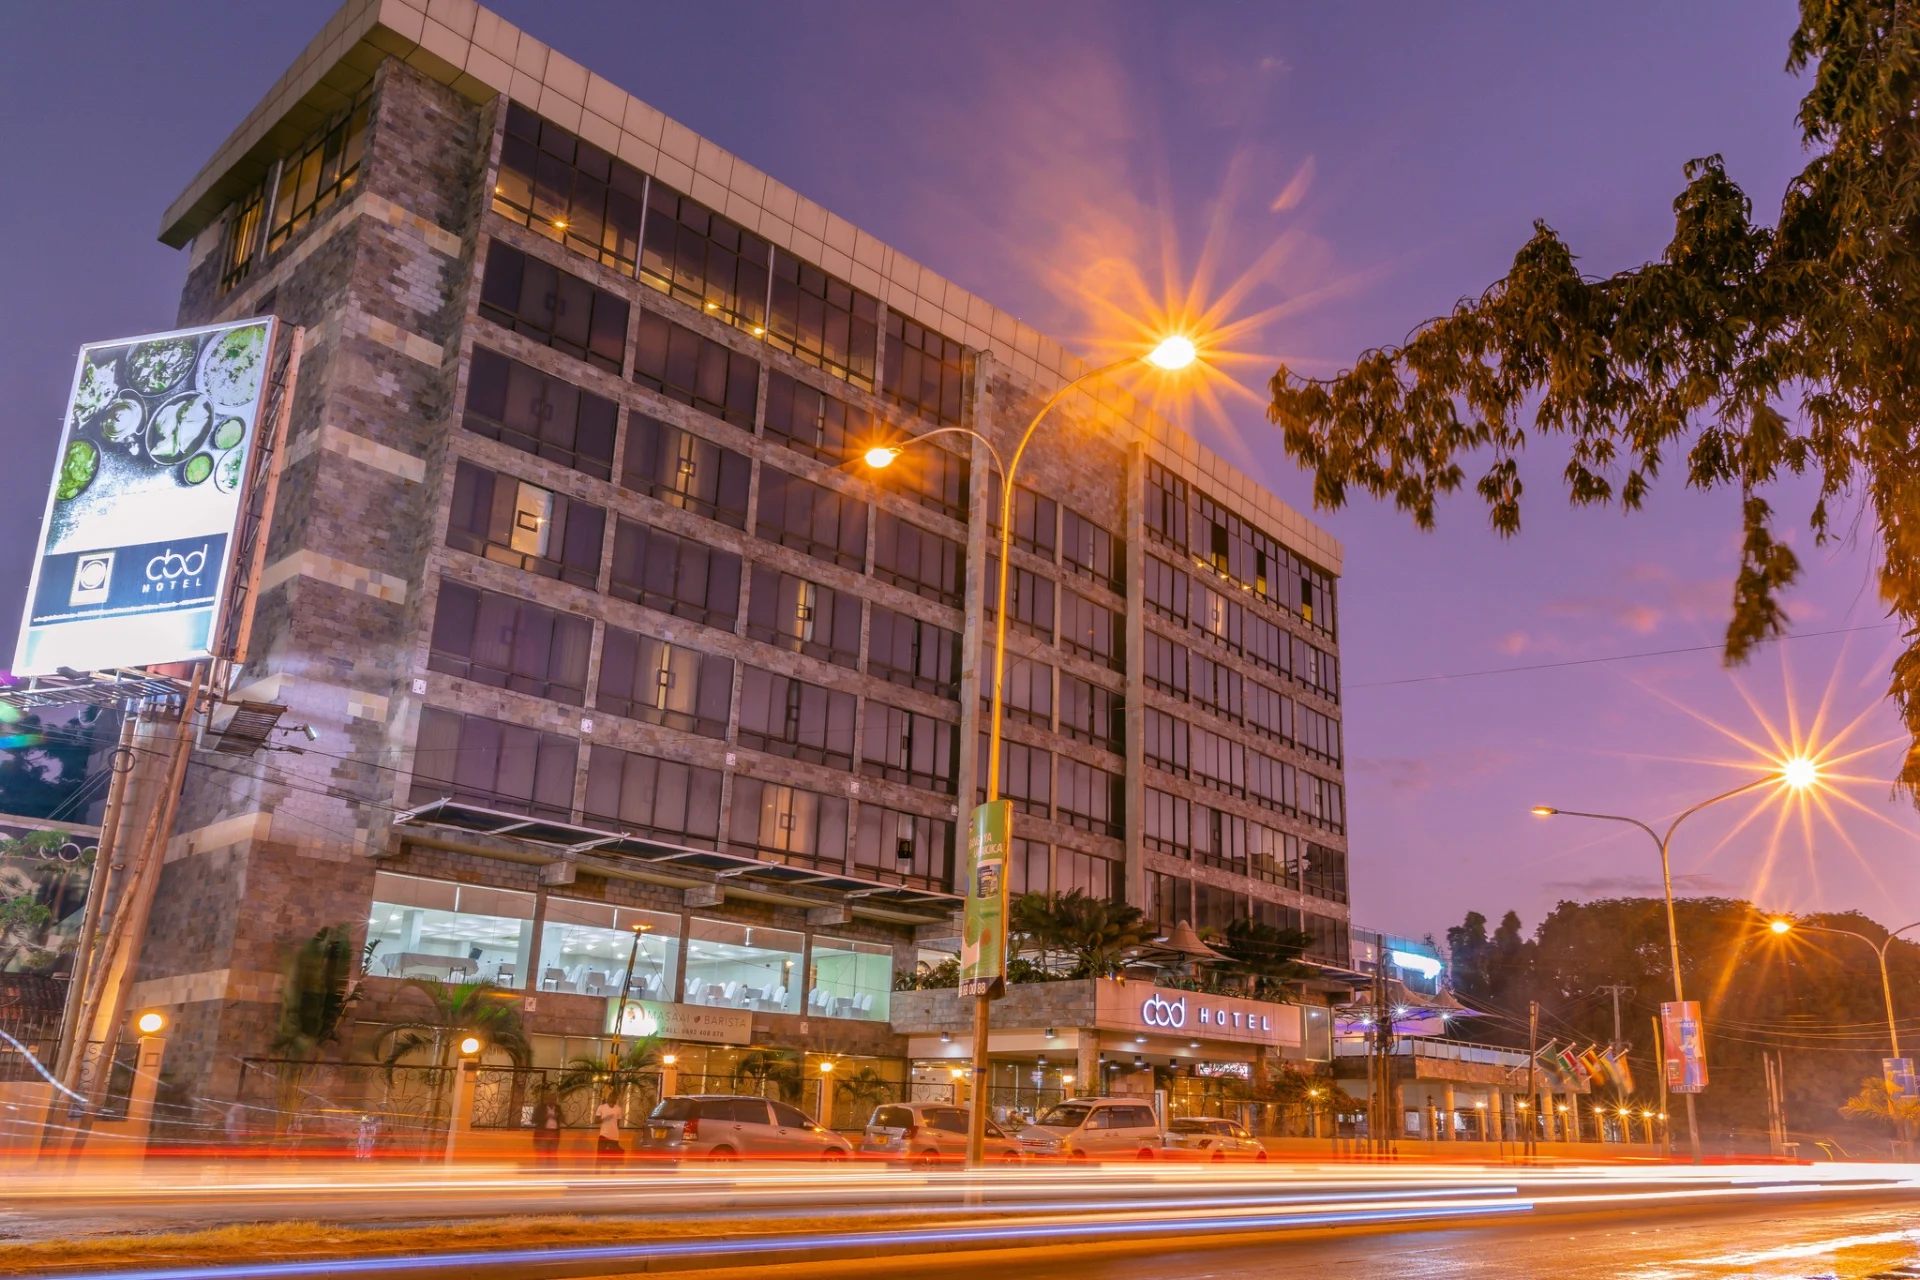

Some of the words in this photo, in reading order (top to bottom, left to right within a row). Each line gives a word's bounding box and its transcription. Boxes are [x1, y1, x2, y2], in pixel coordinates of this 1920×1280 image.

[145, 543, 208, 581] cbd
[142, 577, 202, 594] HOTEL
[977, 982, 986, 995] 88
[647, 1010, 690, 1023] MASAAI
[704, 1015, 746, 1028] BARISTA
[1142, 993, 1186, 1028] cbd
[1199, 1007, 1271, 1031] HOTEL
